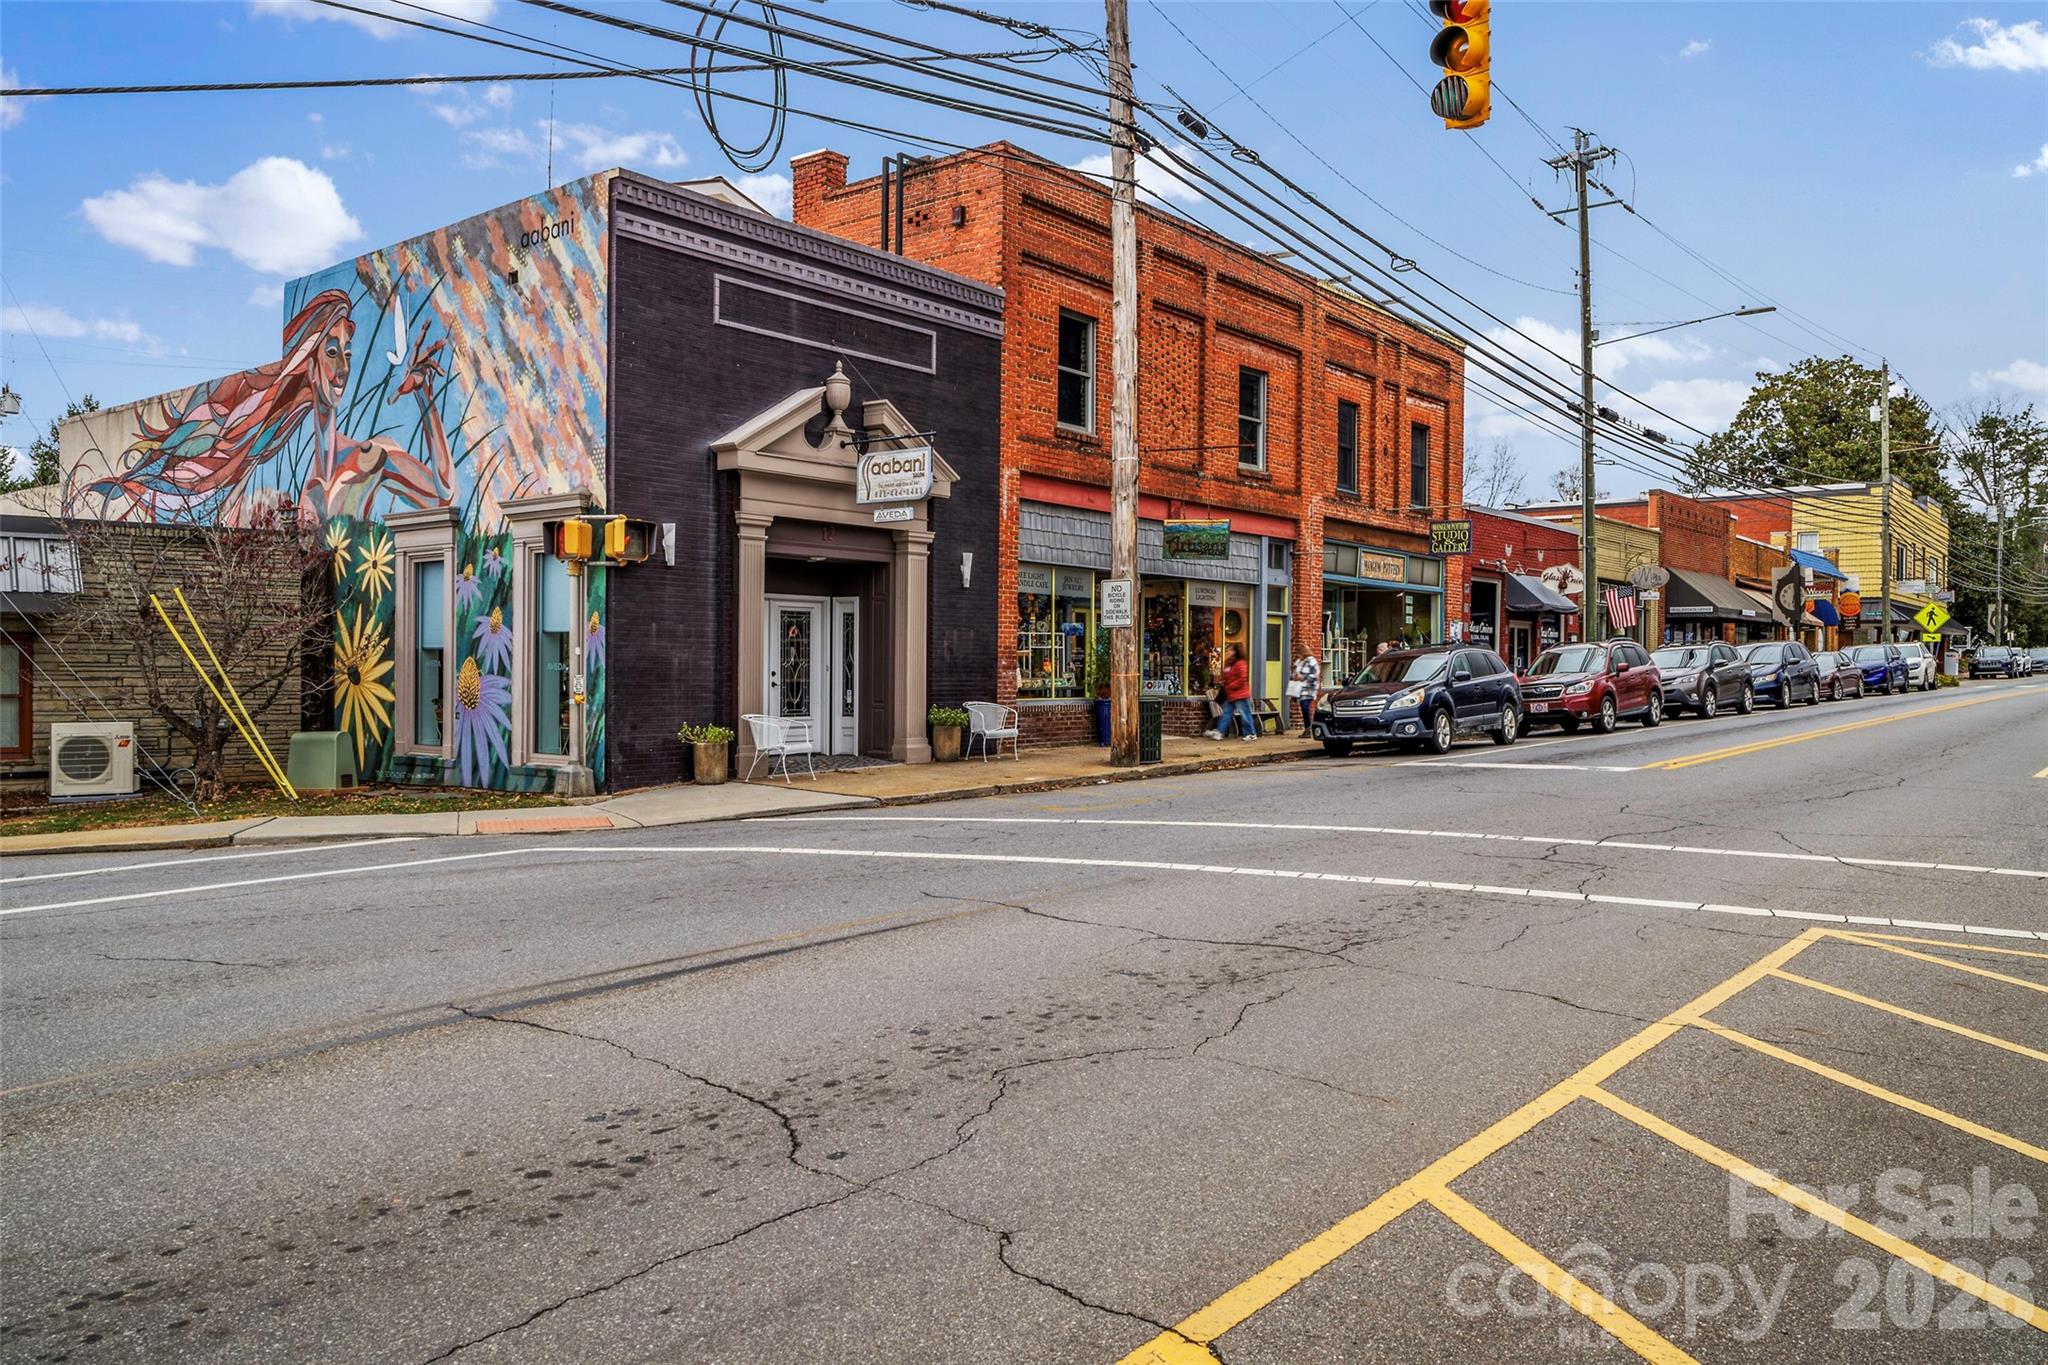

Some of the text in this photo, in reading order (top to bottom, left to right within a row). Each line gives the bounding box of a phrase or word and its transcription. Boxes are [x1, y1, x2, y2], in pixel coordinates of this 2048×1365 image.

[521, 211, 574, 248] aabani
[872, 453, 926, 475] aabani
[876, 510, 908, 520] AVEDA
[1432, 530, 1469, 541] STUDIO
[1432, 541, 1469, 553] GALLERY
[1028, 572, 1044, 580] LIGHT
[1111, 585, 1123, 593] NO
